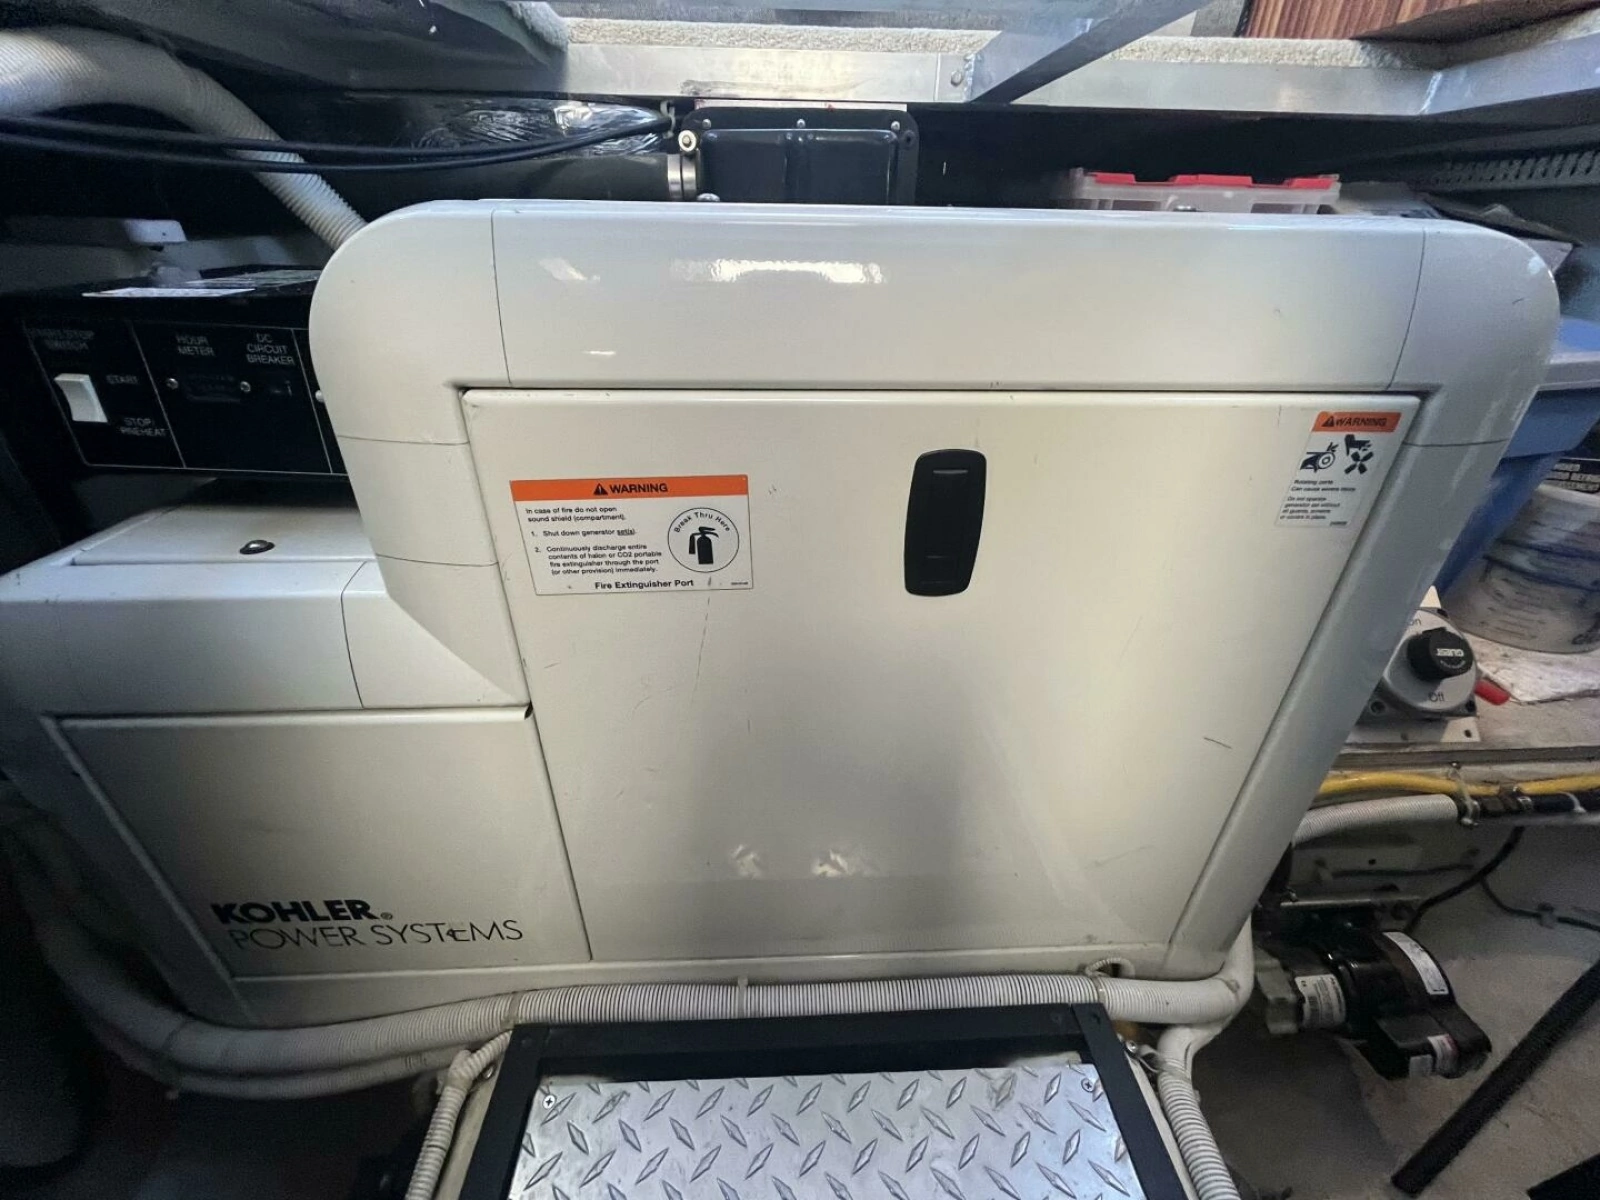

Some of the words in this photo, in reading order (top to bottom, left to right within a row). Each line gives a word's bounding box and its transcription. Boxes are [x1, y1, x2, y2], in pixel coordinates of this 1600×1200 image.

[178, 345, 215, 356] METER
[246, 344, 288, 354] CIRCUIT
[246, 354, 296, 366] BREAKER
[1336, 418, 1388, 427] WARNING
[610, 483, 668, 494] WARNING
[674, 516, 692, 533] Break
[694, 512, 714, 520] Thru
[714, 516, 731, 532] Here
[582, 529, 614, 537] generator
[562, 560, 603, 568] extinguisher
[604, 560, 630, 568] through
[645, 558, 659, 566] port
[582, 567, 614, 575] provision)
[614, 580, 672, 590] Extinguisher
[228, 924, 366, 950] POWER
[370, 920, 523, 944] SYSTEMS
